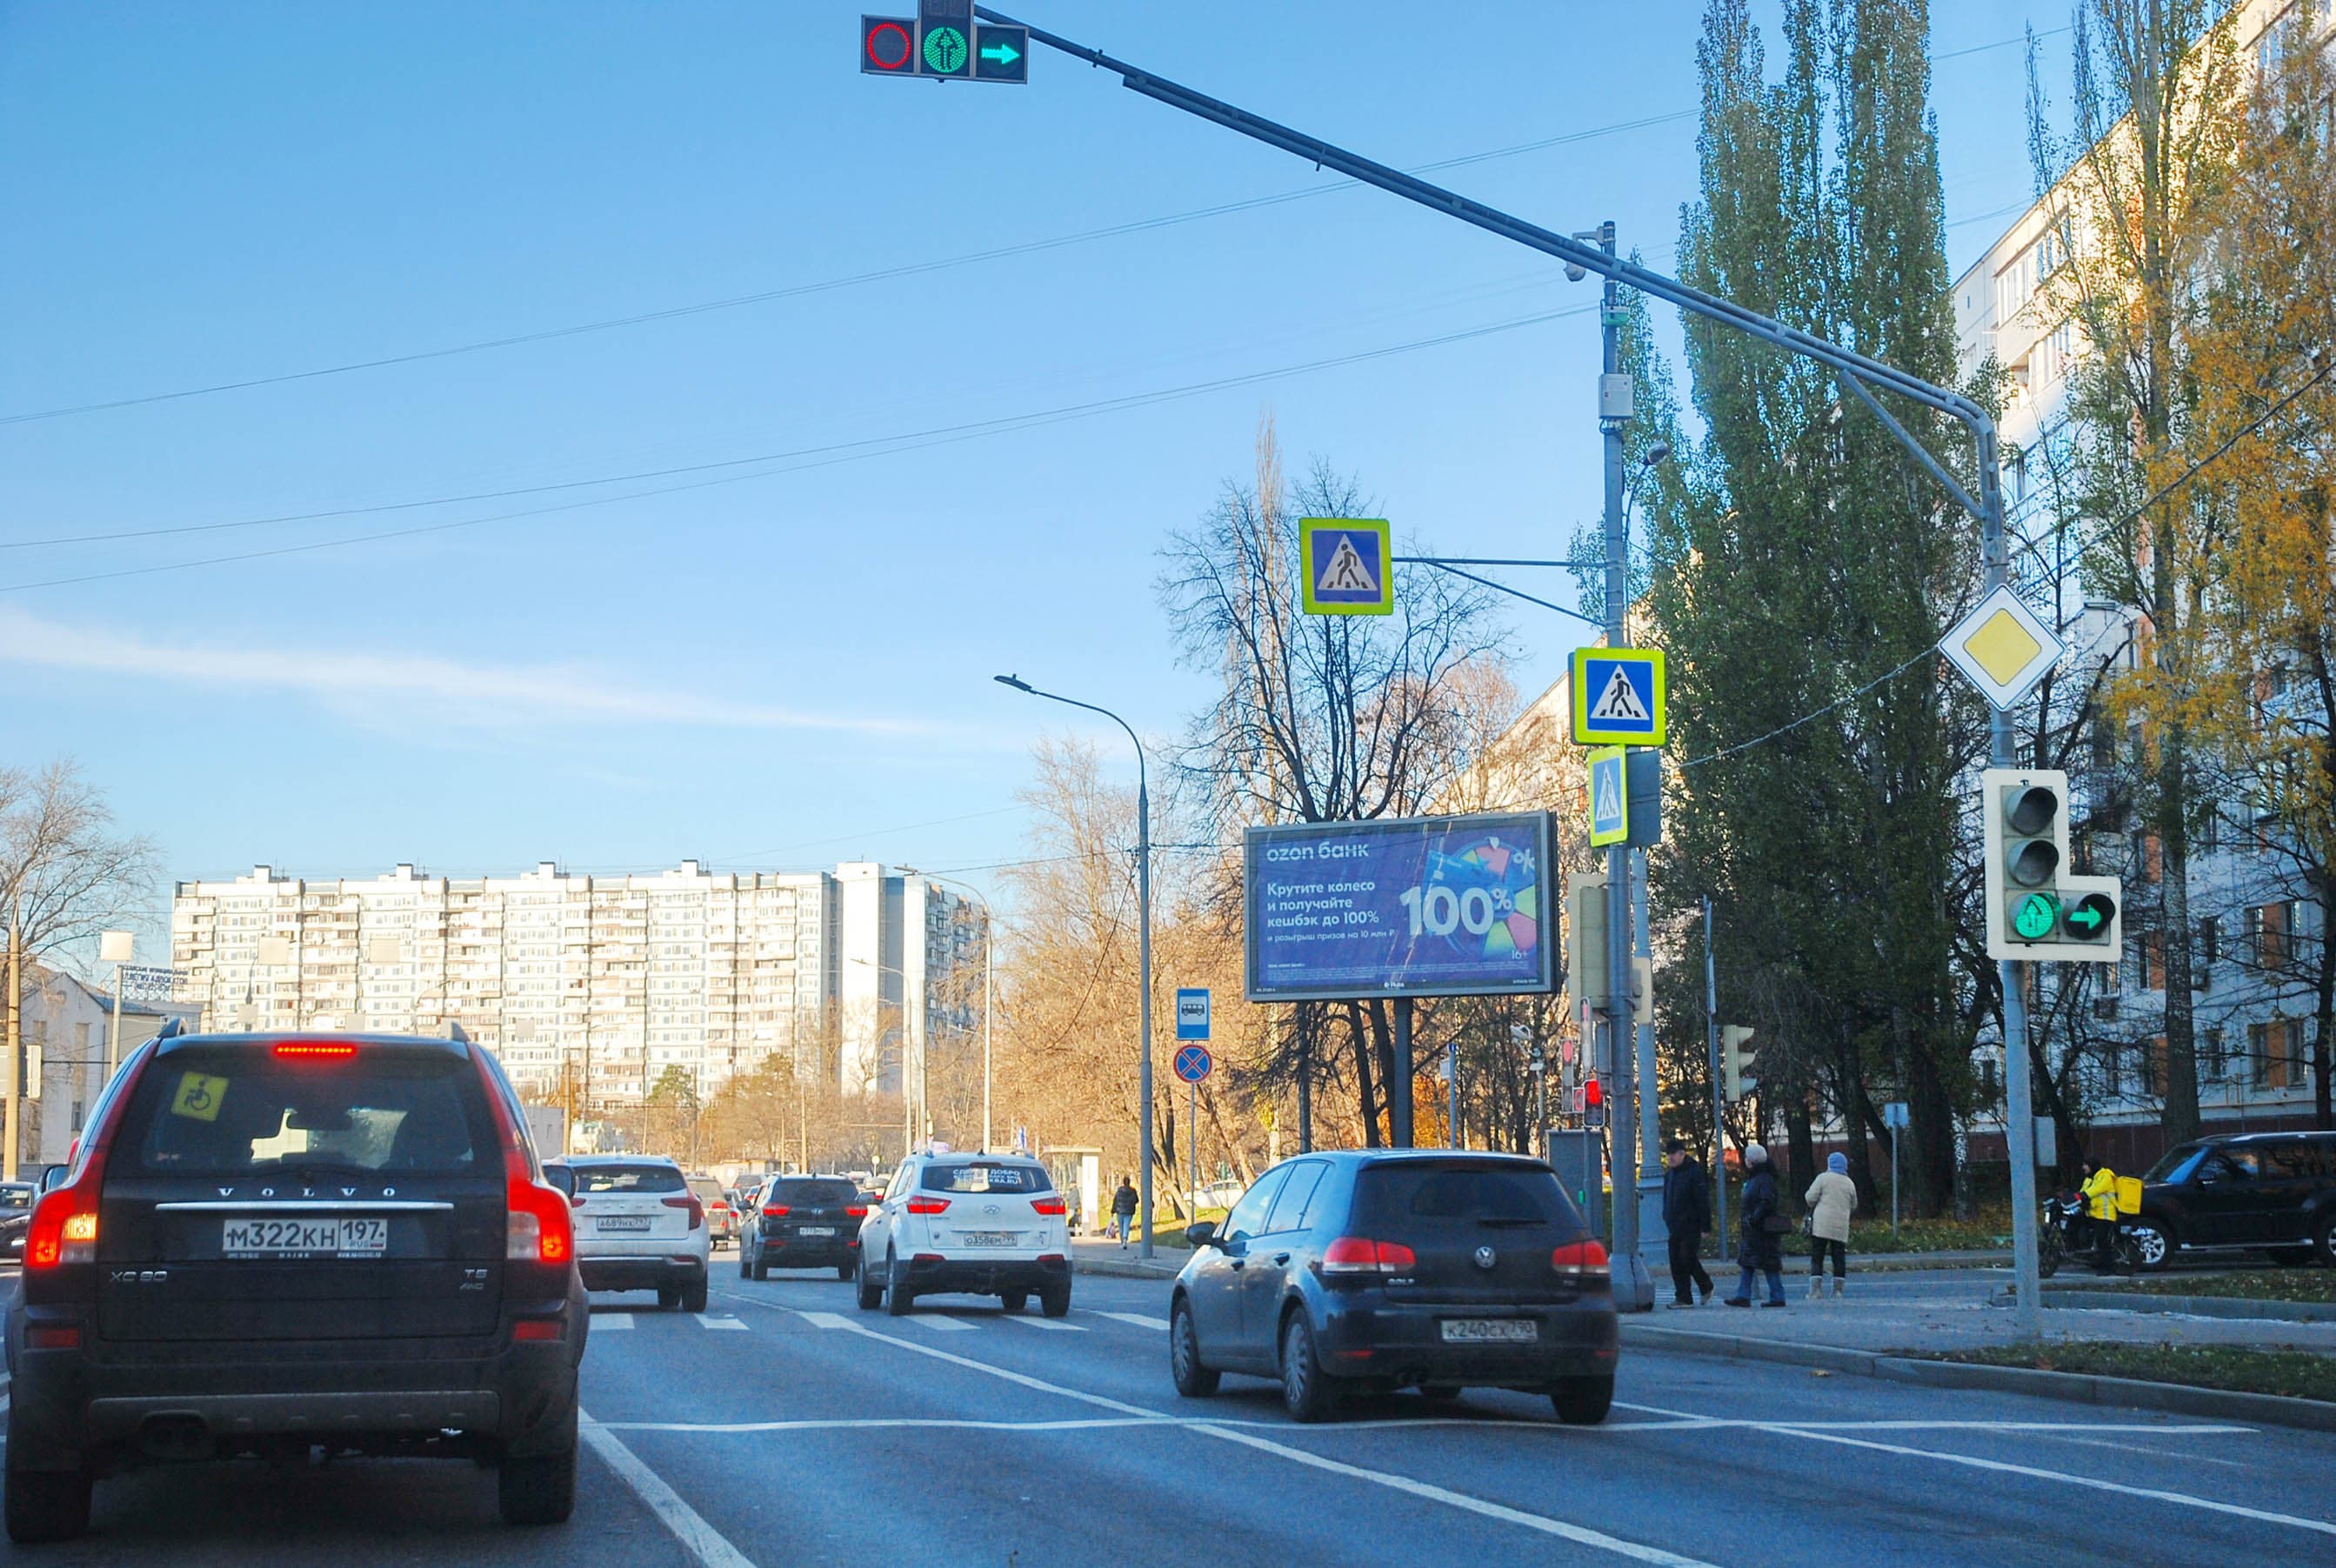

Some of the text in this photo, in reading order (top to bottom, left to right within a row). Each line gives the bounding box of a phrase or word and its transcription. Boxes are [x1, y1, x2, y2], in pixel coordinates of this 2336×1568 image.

[1266, 841, 1370, 862] ozon банк
[1267, 881, 1376, 897] Крутите колесо
[1267, 897, 1352, 913] и получайте
[1399, 885, 1512, 936] 100%
[1267, 911, 1380, 928] кешбэк до 100%
[1274, 933, 1315, 943] розыгрыш
[1317, 932, 1345, 942] призов
[1360, 930, 1369, 938] 10
[1512, 949, 1529, 960] 16+
[217, 1187, 397, 1197] VOLVO
[230, 1220, 380, 1248] М322КН 197
